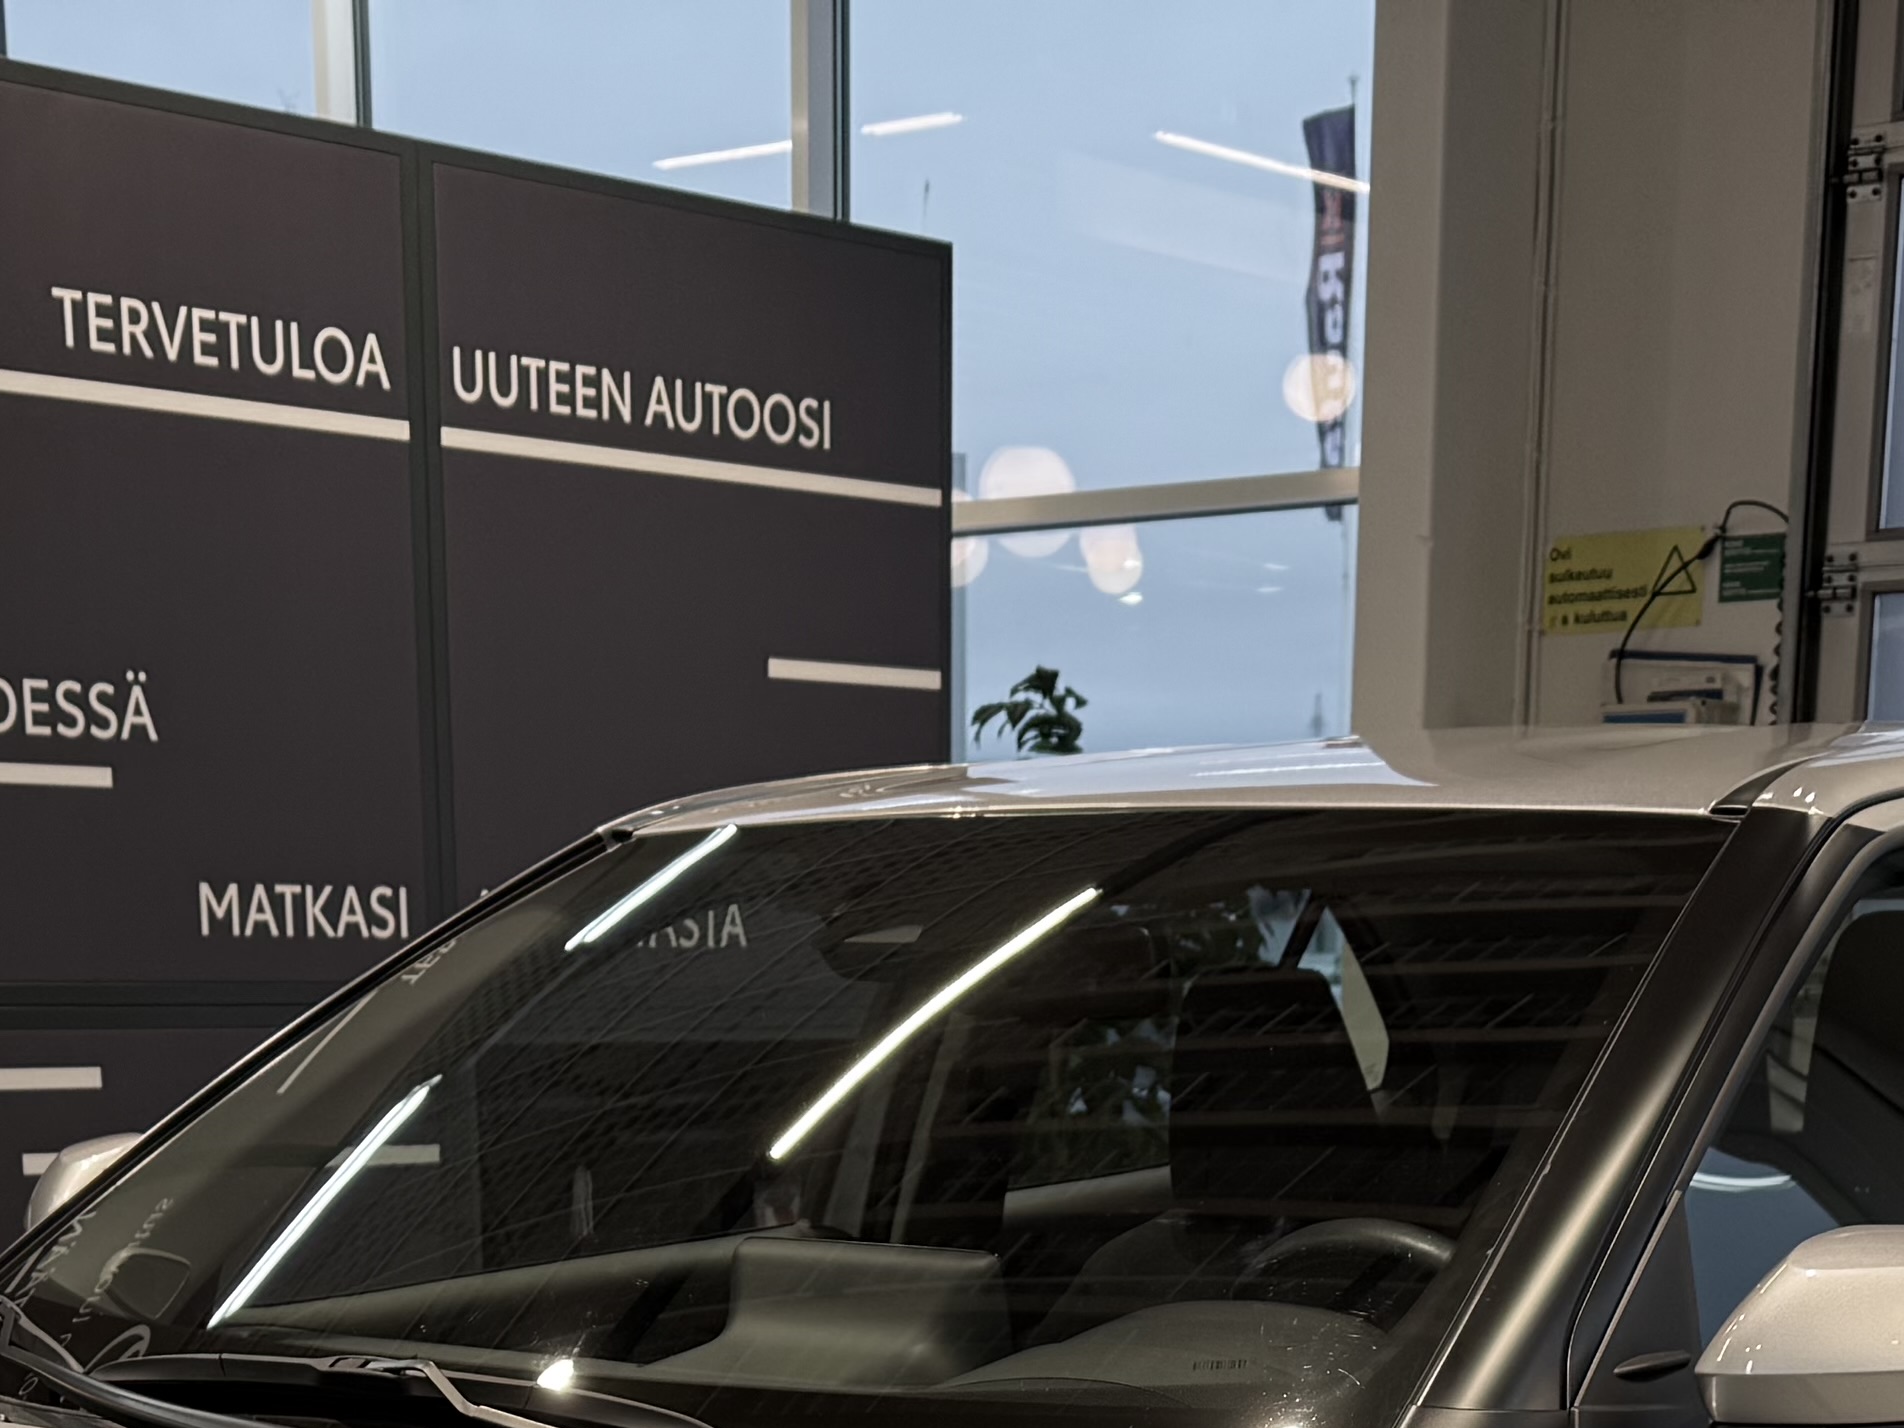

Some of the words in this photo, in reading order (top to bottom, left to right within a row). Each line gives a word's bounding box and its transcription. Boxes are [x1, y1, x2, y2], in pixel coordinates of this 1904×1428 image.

[50, 286, 392, 391] TERVETULOA
[451, 344, 633, 425] UUTEEN
[643, 375, 832, 451] AUTOOSI
[197, 881, 410, 940] MATKASI
